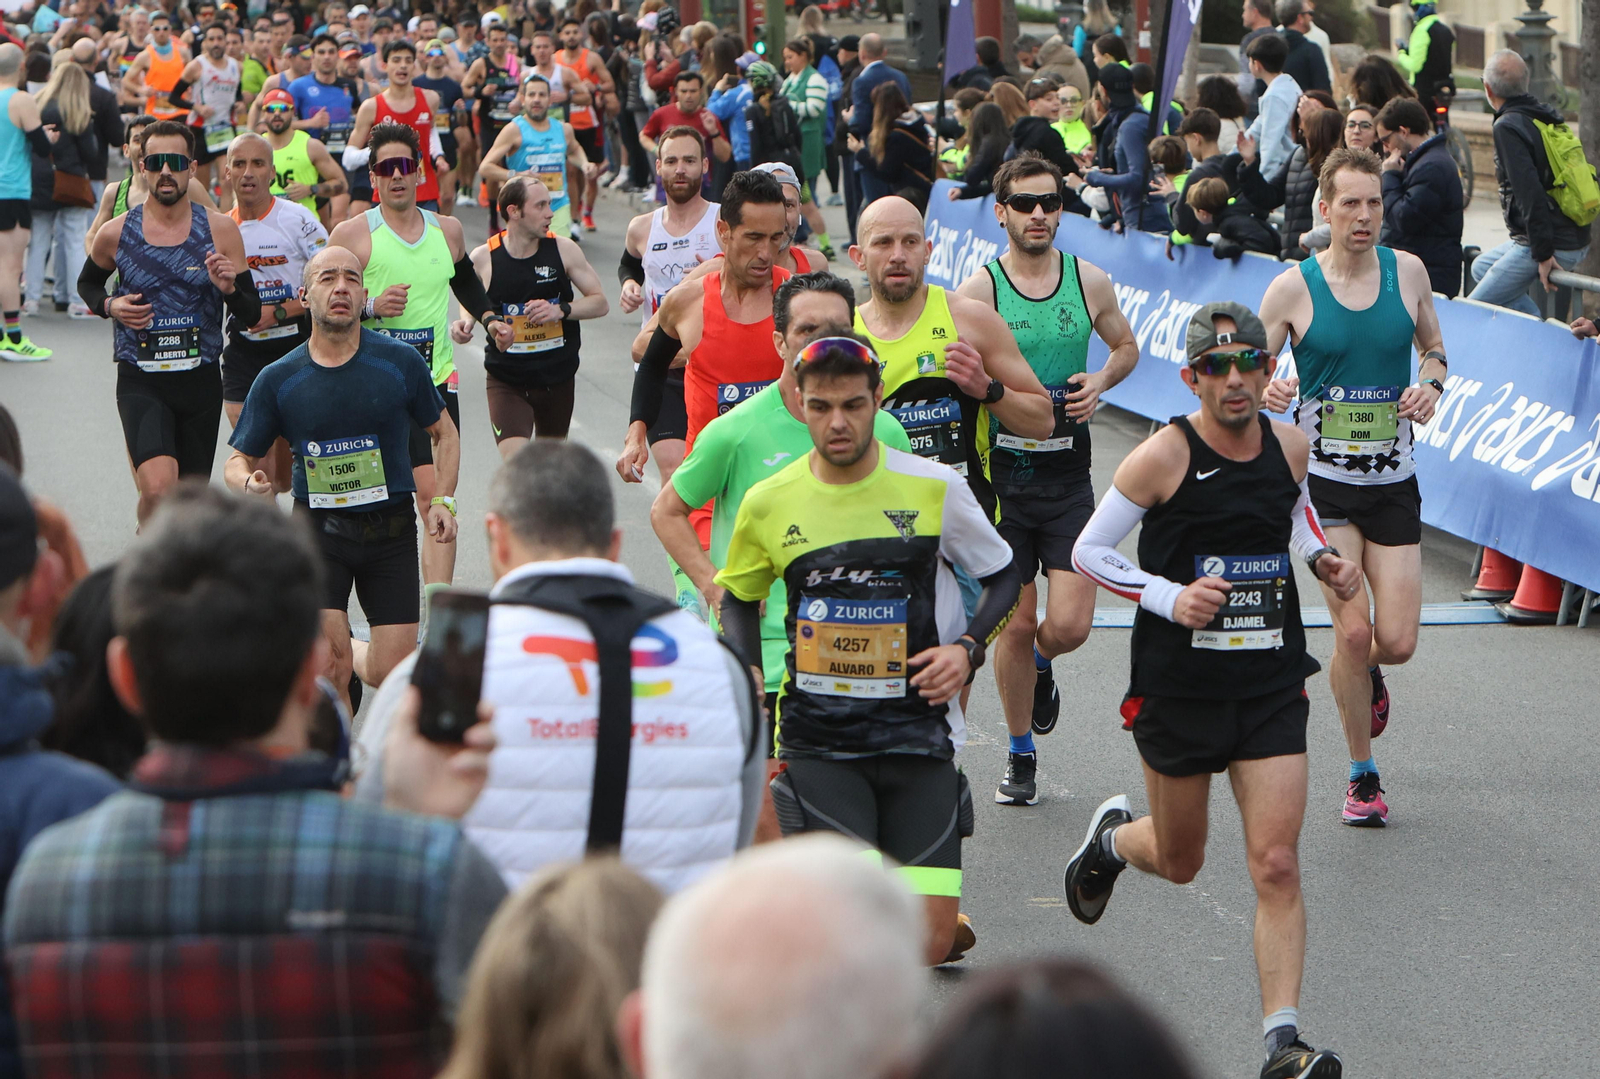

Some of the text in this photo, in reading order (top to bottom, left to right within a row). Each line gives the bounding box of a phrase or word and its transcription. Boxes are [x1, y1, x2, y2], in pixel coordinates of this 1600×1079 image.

[1386, 268, 1394, 293] soar
[157, 315, 194, 328] ZURICH
[157, 335, 181, 347] 2288
[394, 330, 428, 342] ZURICH
[523, 332, 546, 342] ALEXIS
[154, 349, 187, 360] ALBERTO
[1349, 389, 1391, 400] ZURICH
[899, 406, 950, 423] ZURICH
[1348, 411, 1374, 423] 1380
[1350, 430, 1371, 440] DOM
[1471, 395, 1576, 474] asics
[325, 438, 370, 454] ZURICH
[328, 461, 356, 476] 1506
[329, 479, 362, 492] VICTOR
[1231, 559, 1280, 574] ZURICH
[1228, 590, 1262, 607] 2243
[833, 605, 895, 620] ZURICH
[1222, 615, 1267, 629] DJAMEL
[832, 636, 871, 653] 4257
[828, 661, 875, 676] ALVARO
[526, 717, 689, 745] TotalErgies
